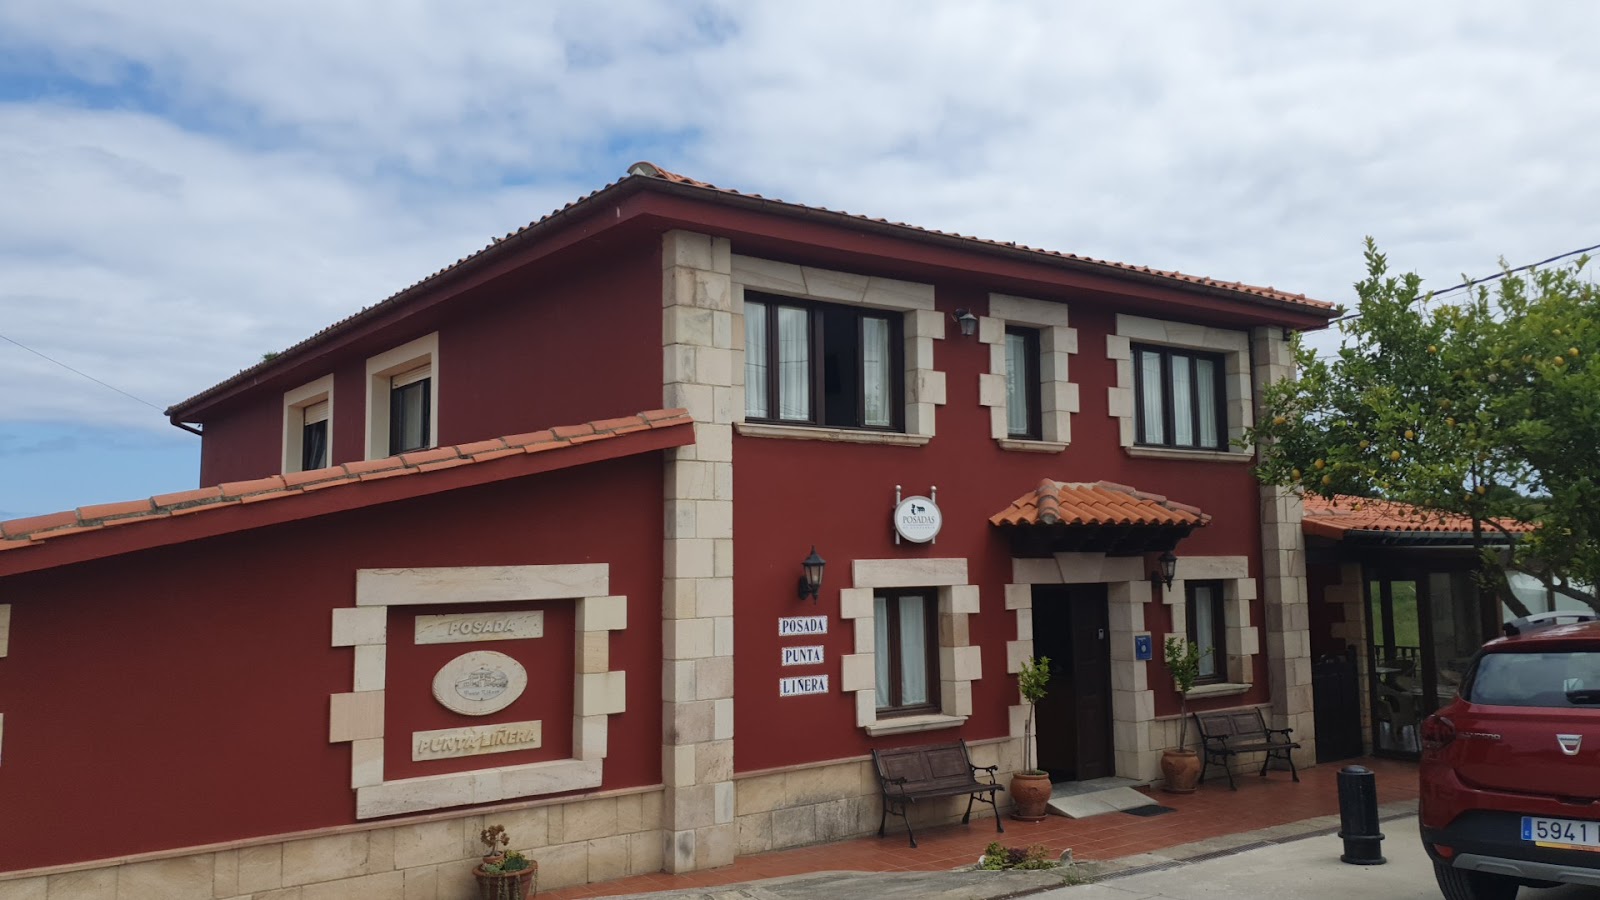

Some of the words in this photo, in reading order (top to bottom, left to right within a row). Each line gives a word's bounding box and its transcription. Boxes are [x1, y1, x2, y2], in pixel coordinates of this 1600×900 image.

[902, 515, 935, 524] POSADAS
[448, 619, 515, 636] POSADA
[782, 618, 824, 633] POSADA
[785, 648, 820, 663] PUNTA
[418, 735, 476, 754] PUNTA
[479, 726, 536, 748] LIÑERA
[1537, 820, 1586, 842] 5941
